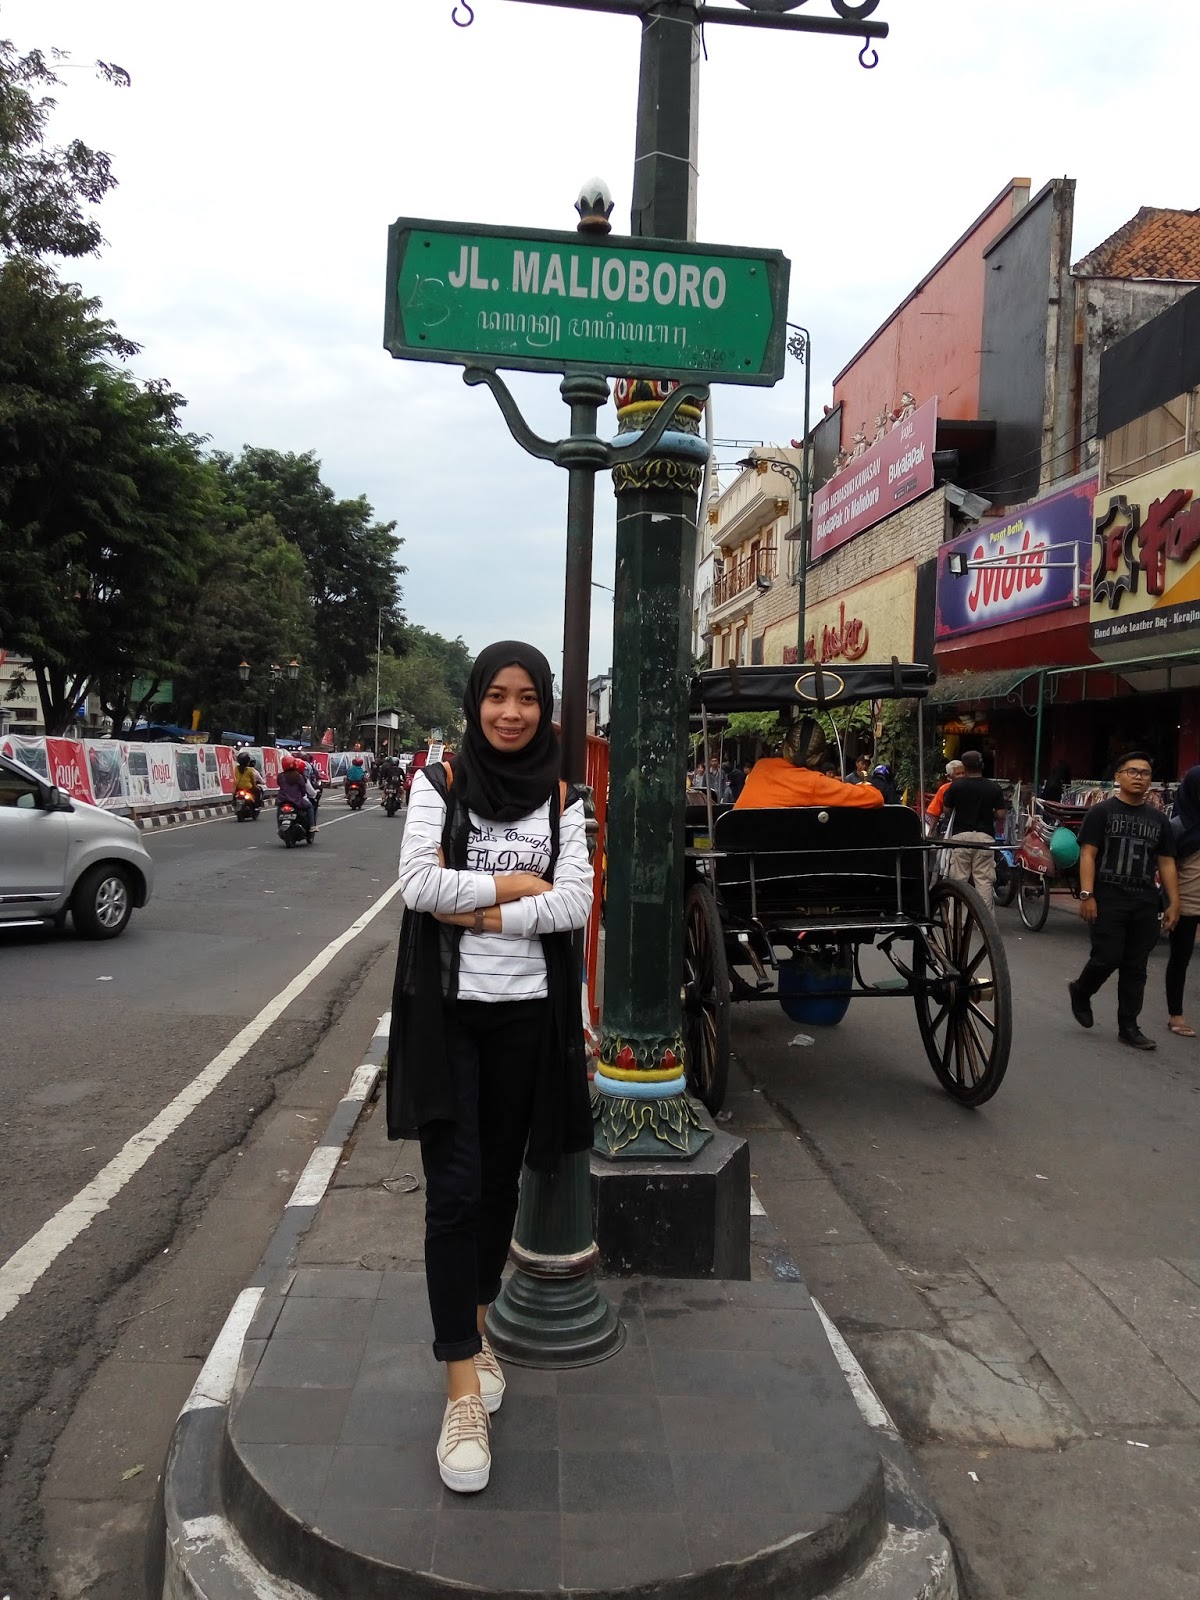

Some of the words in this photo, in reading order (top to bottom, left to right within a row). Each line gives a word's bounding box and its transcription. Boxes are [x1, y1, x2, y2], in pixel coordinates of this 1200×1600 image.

[448, 245, 499, 291] JL.
[512, 250, 726, 309] MALIOBORO
[989, 528, 1006, 544] Pusat
[1007, 519, 1024, 537] Batik
[1094, 627, 1110, 639] Hand
[1111, 625, 1128, 636] Made
[1129, 620, 1153, 632] Leather
[1155, 616, 1168, 628] Bag
[467, 825, 497, 845] orld's
